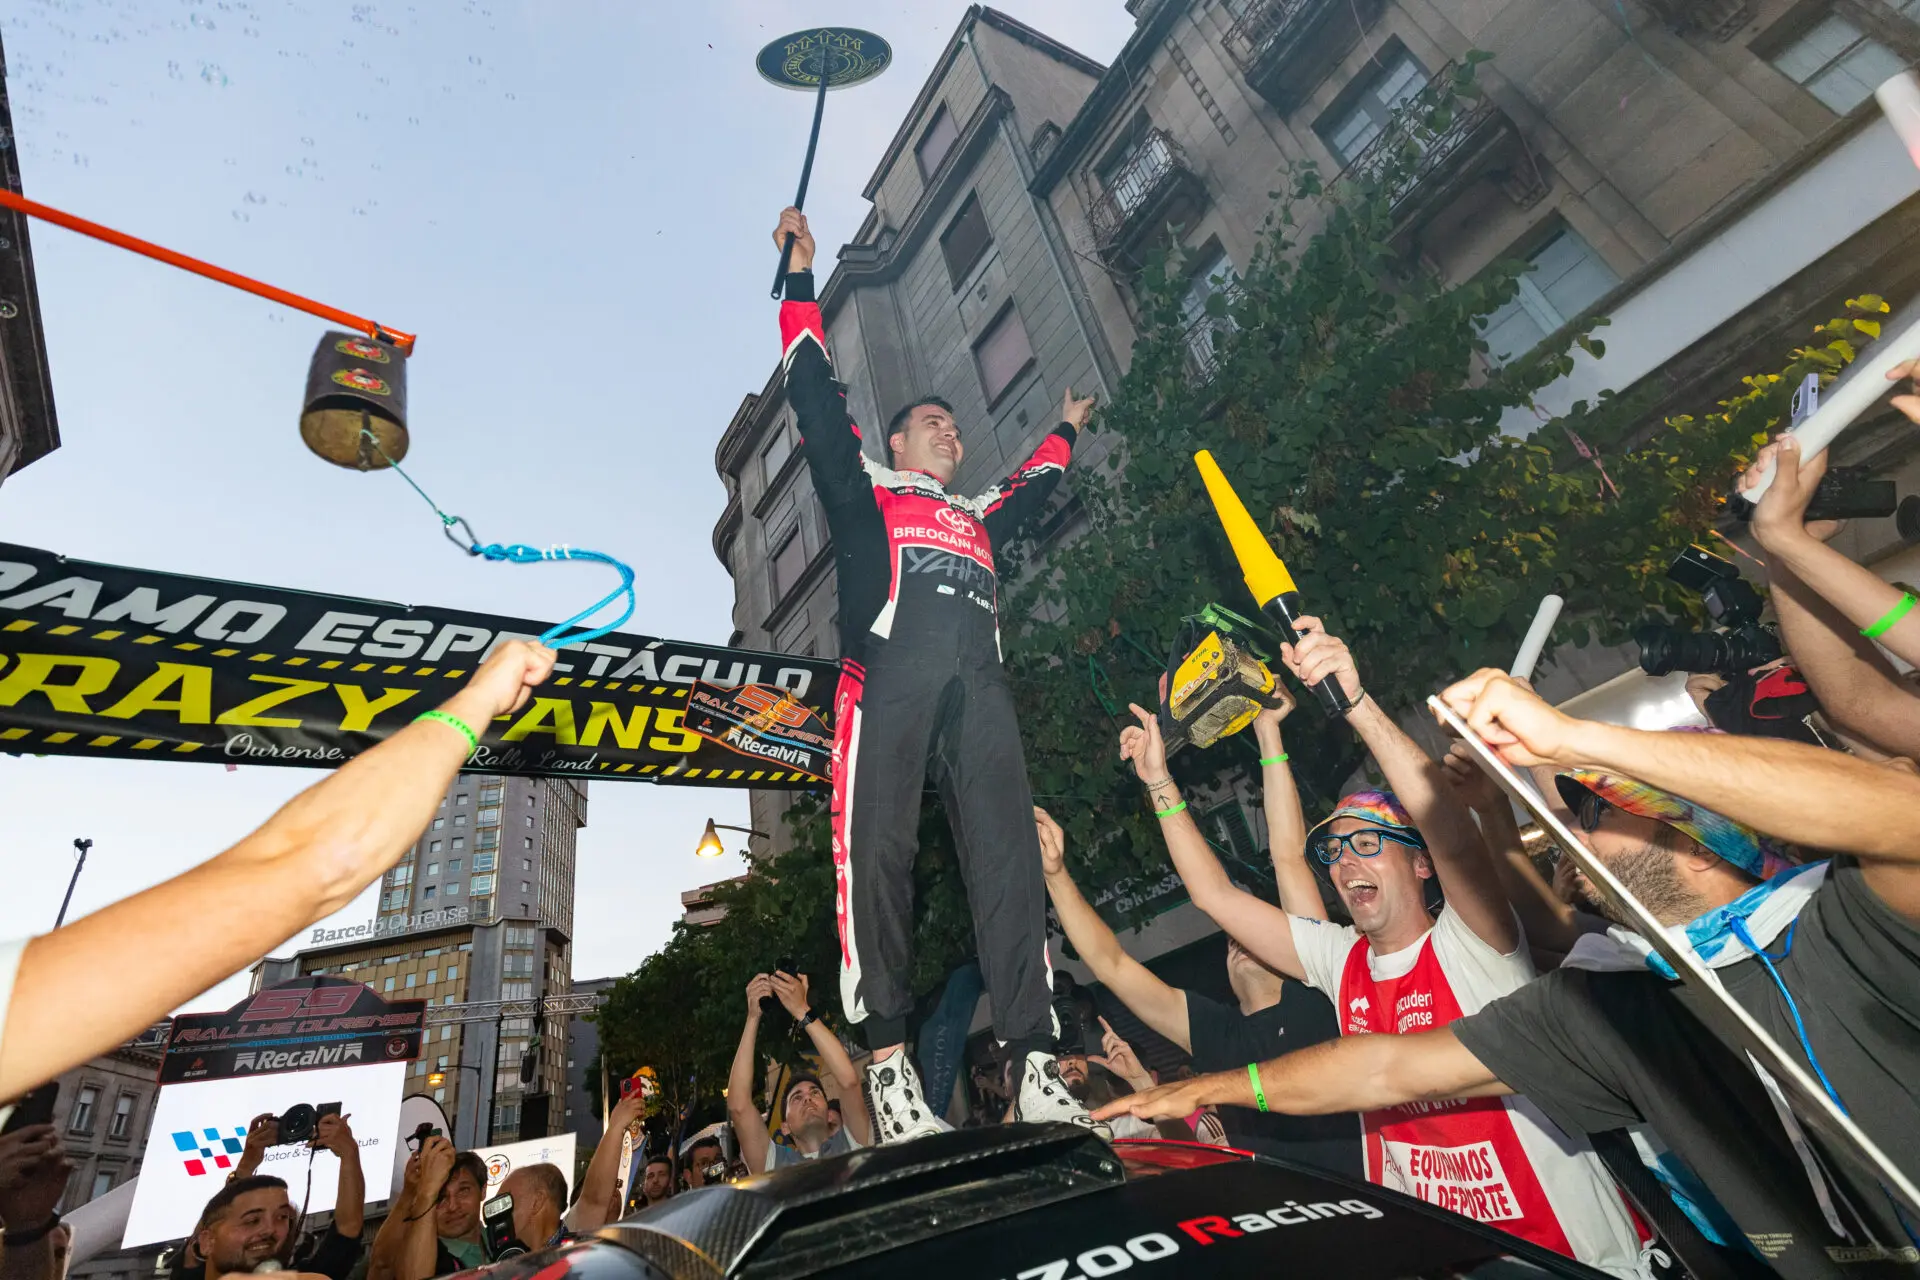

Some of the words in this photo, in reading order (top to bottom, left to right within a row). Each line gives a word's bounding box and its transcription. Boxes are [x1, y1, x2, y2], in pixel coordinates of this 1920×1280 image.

[916, 487, 945, 501] TOYOT
[894, 527, 971, 549] BREOGÁN
[0, 652, 421, 732] RAZY
[492, 696, 703, 753] ANS
[693, 691, 768, 729] RALLYE
[733, 685, 812, 728] 59
[467, 745, 527, 771] Rally
[539, 751, 598, 771] Land
[738, 733, 799, 764] Recalvi
[311, 918, 383, 944] Barceló
[388, 906, 469, 931] Ourense
[238, 985, 364, 1021] 59
[174, 1021, 297, 1043] RALLYE
[296, 1011, 421, 1033] OURENSE
[1397, 1011, 1433, 1035] ourense
[255, 1044, 345, 1070] Recalvi
[1410, 1147, 1493, 1182] EQUIPAMOS
[1438, 1182, 1513, 1220] DEPORTE
[1006, 1232, 1180, 1280] ZOO
[1176, 1199, 1385, 1246] Racing
